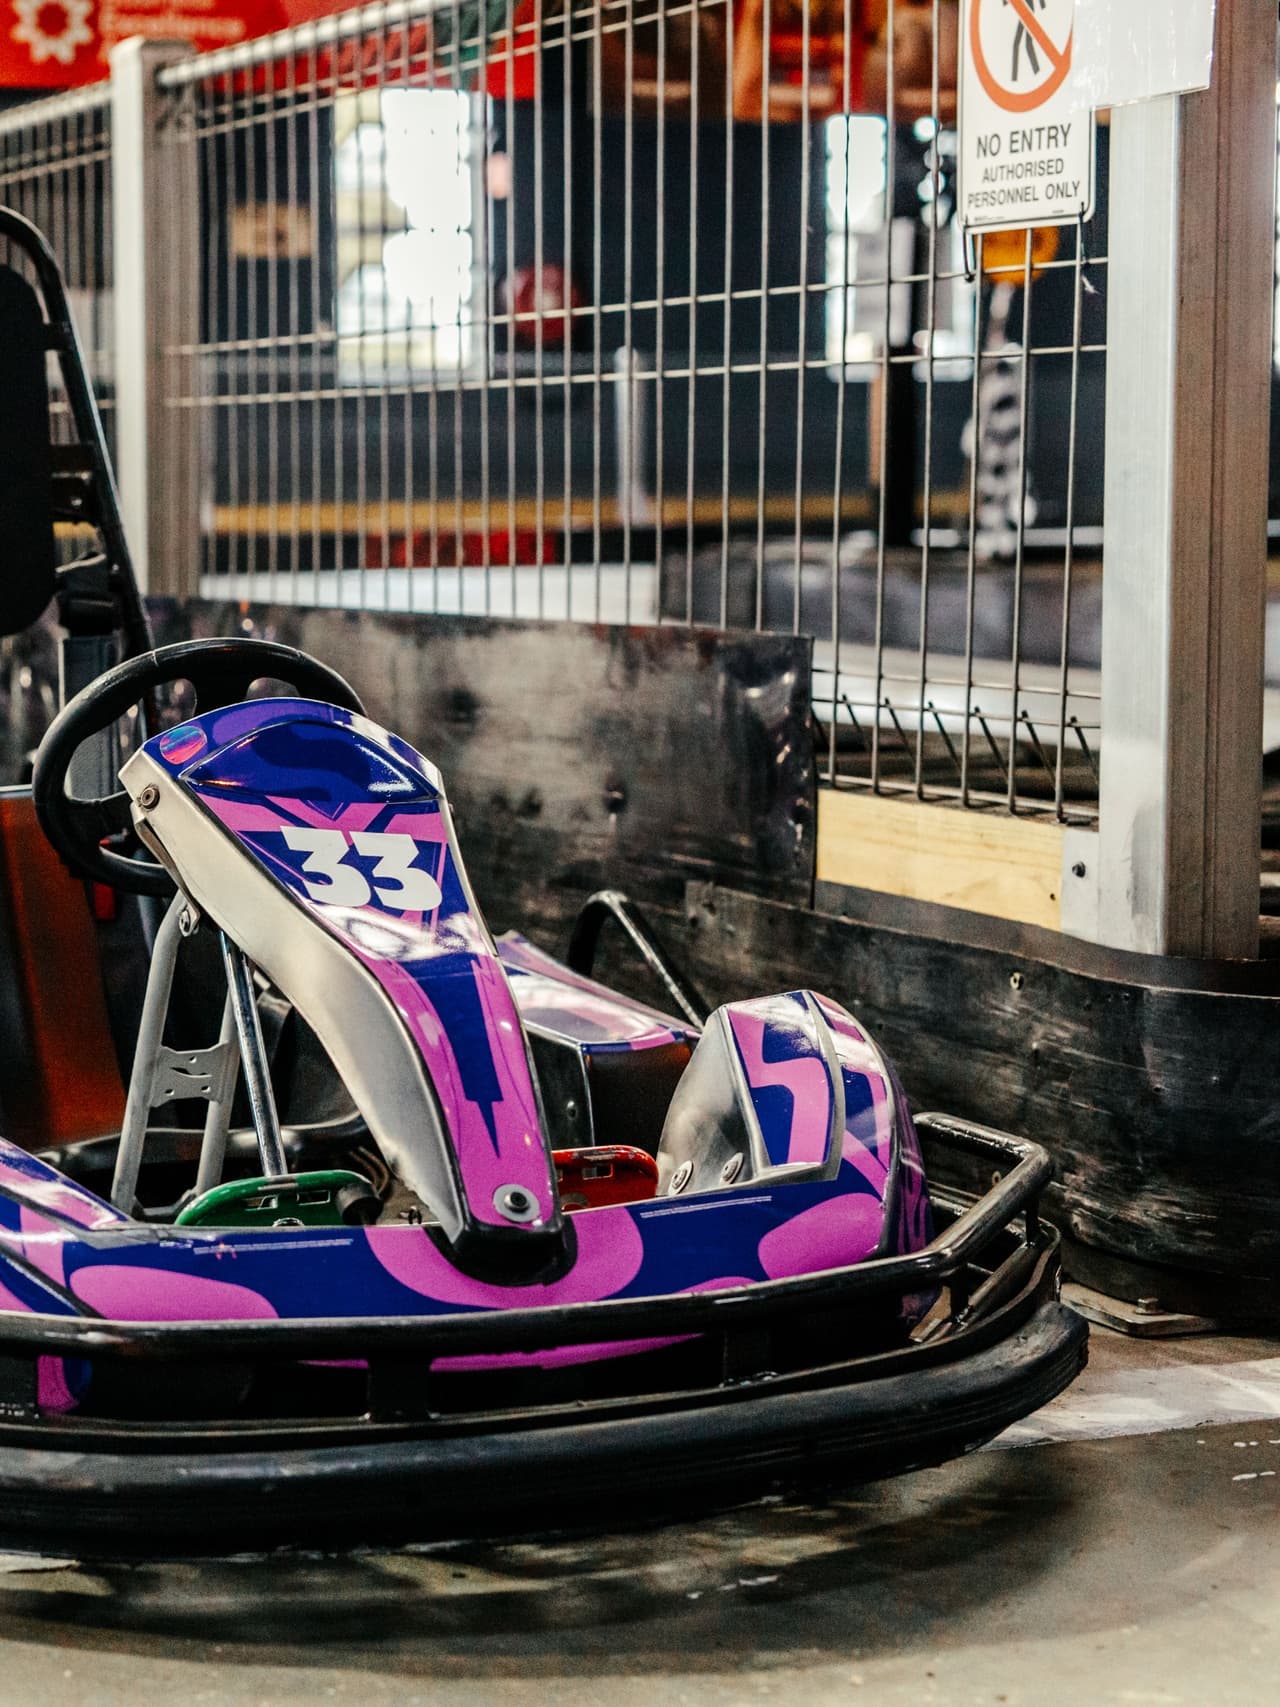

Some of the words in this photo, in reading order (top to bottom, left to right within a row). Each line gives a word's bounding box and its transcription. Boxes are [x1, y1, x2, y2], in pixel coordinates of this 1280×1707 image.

[976, 133, 1001, 159] NO
[1009, 122, 1072, 154] ENTRY
[982, 158, 1064, 184] AUTHORISED
[968, 187, 1039, 208] PERSONNEL
[1045, 180, 1081, 200] ONLY
[280, 825, 443, 912] 33
